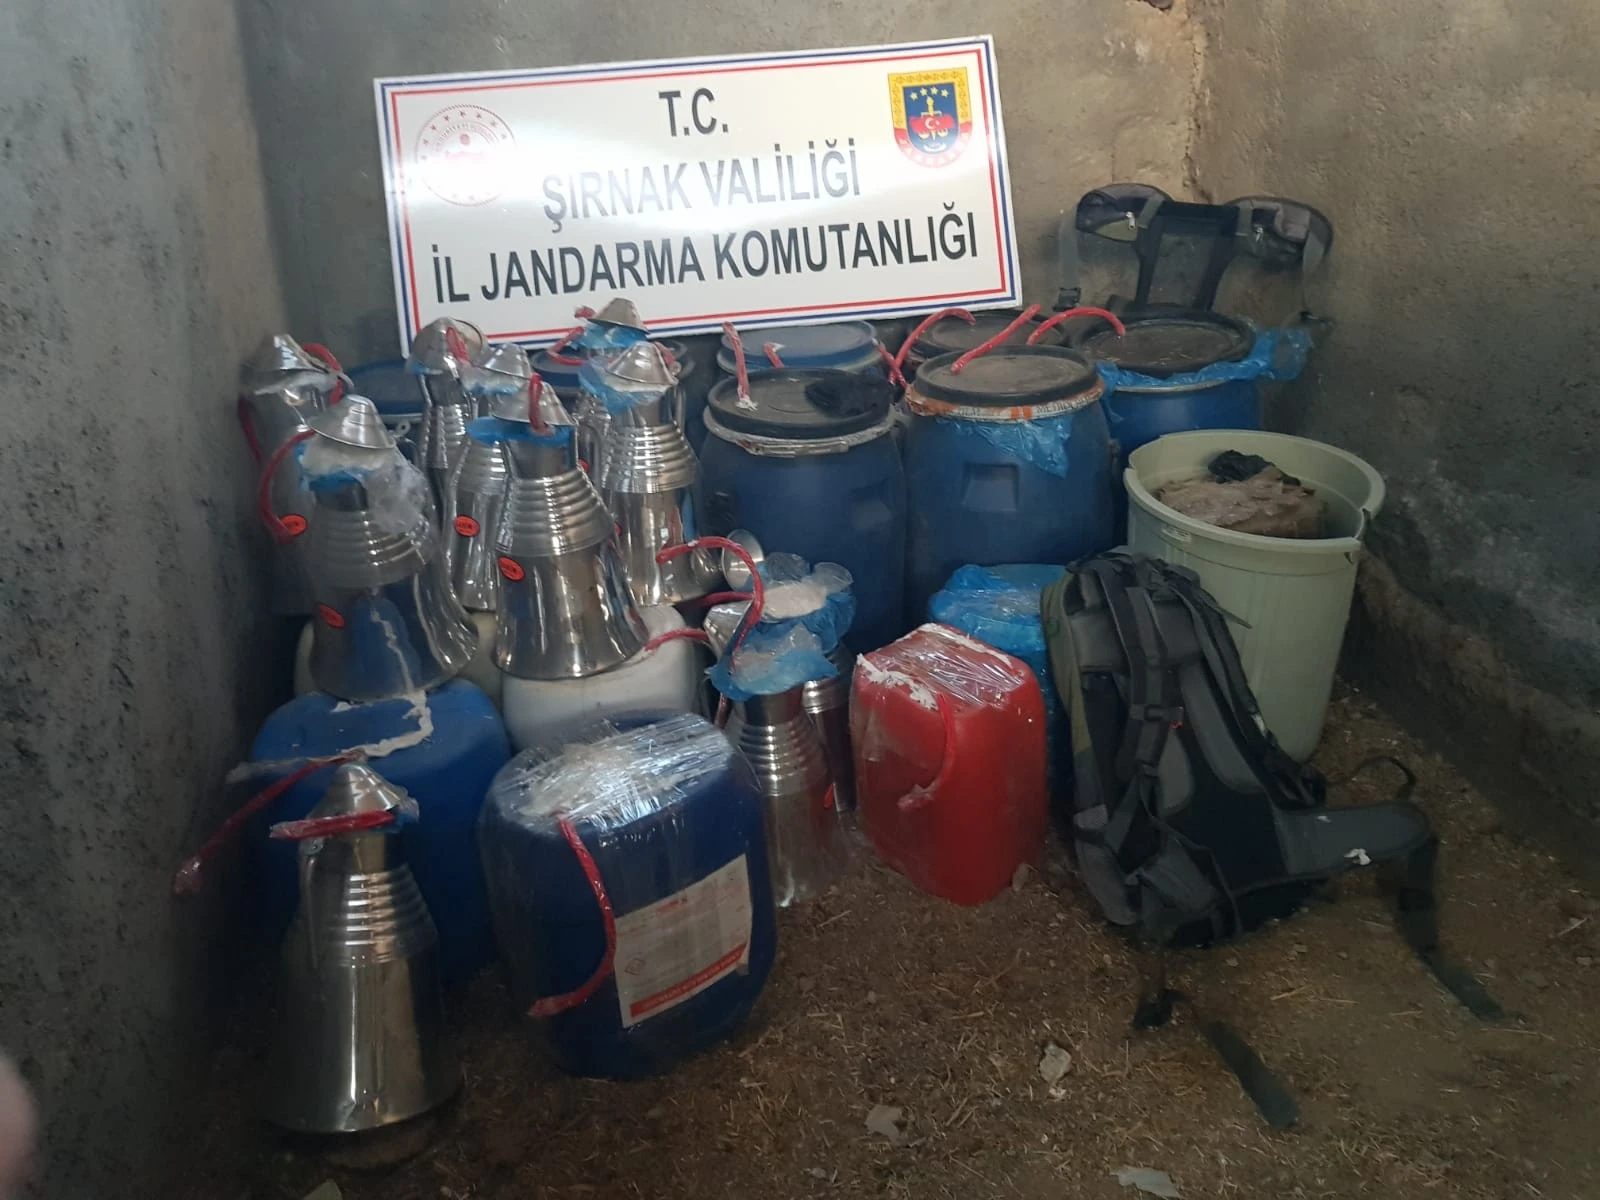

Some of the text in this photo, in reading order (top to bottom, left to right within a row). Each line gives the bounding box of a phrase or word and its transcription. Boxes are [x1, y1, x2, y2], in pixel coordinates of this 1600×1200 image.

[658, 87, 728, 137] T.C.
[542, 162, 692, 233] ŞIRNAK
[699, 137, 860, 207] VALİLİĞİ
[432, 201, 978, 303] İL JANDARMA KOMUTANLIĞI
